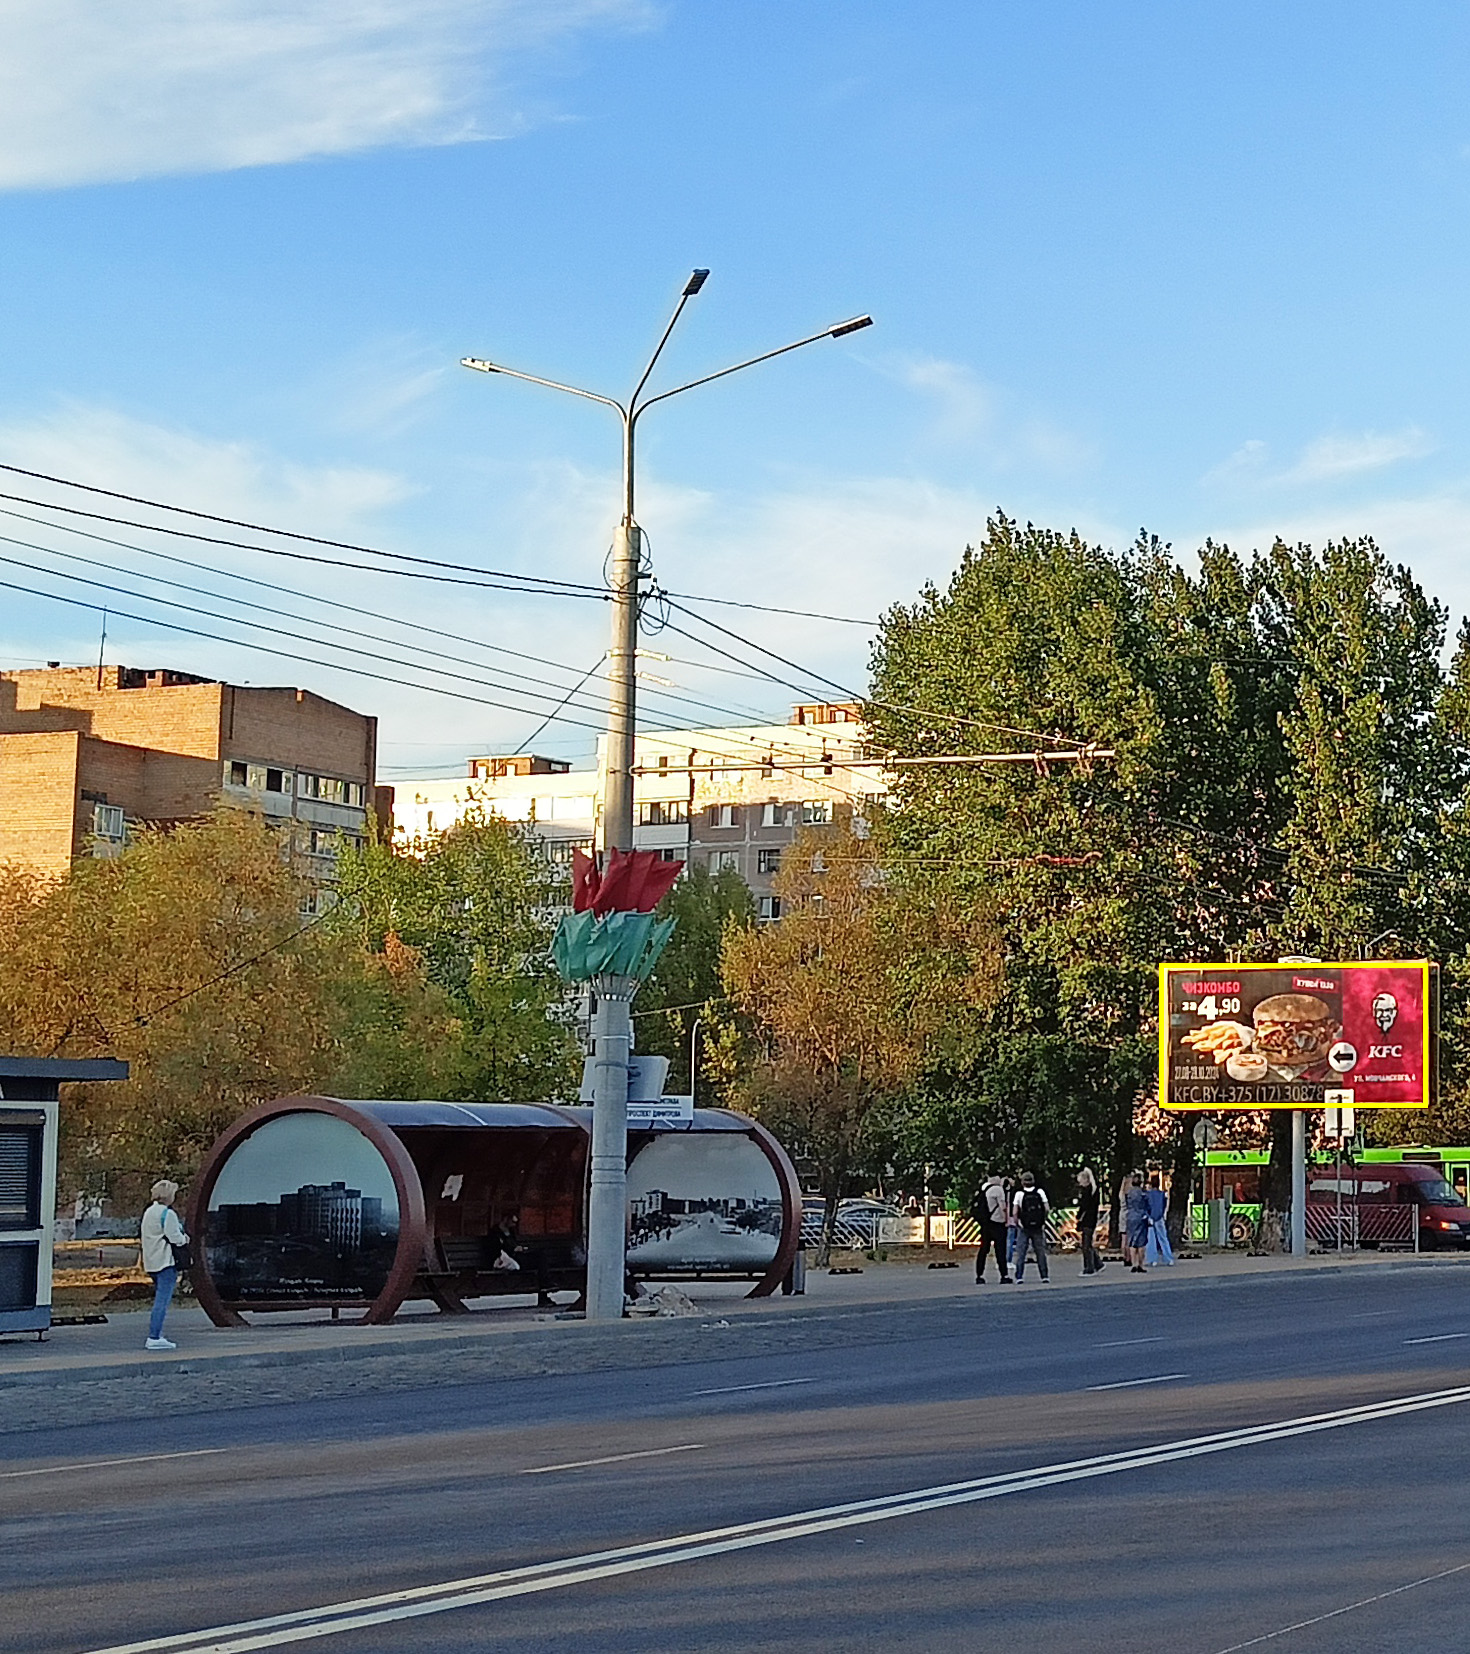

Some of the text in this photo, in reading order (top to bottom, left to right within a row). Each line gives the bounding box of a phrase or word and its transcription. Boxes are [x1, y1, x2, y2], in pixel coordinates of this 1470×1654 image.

[1182, 981, 1241, 994] ЧИЗКОМБО
[1368, 1045, 1403, 1058] KFC
[1255, 1086, 1281, 1102] (17)
[1285, 1085, 1324, 1101] 30878
